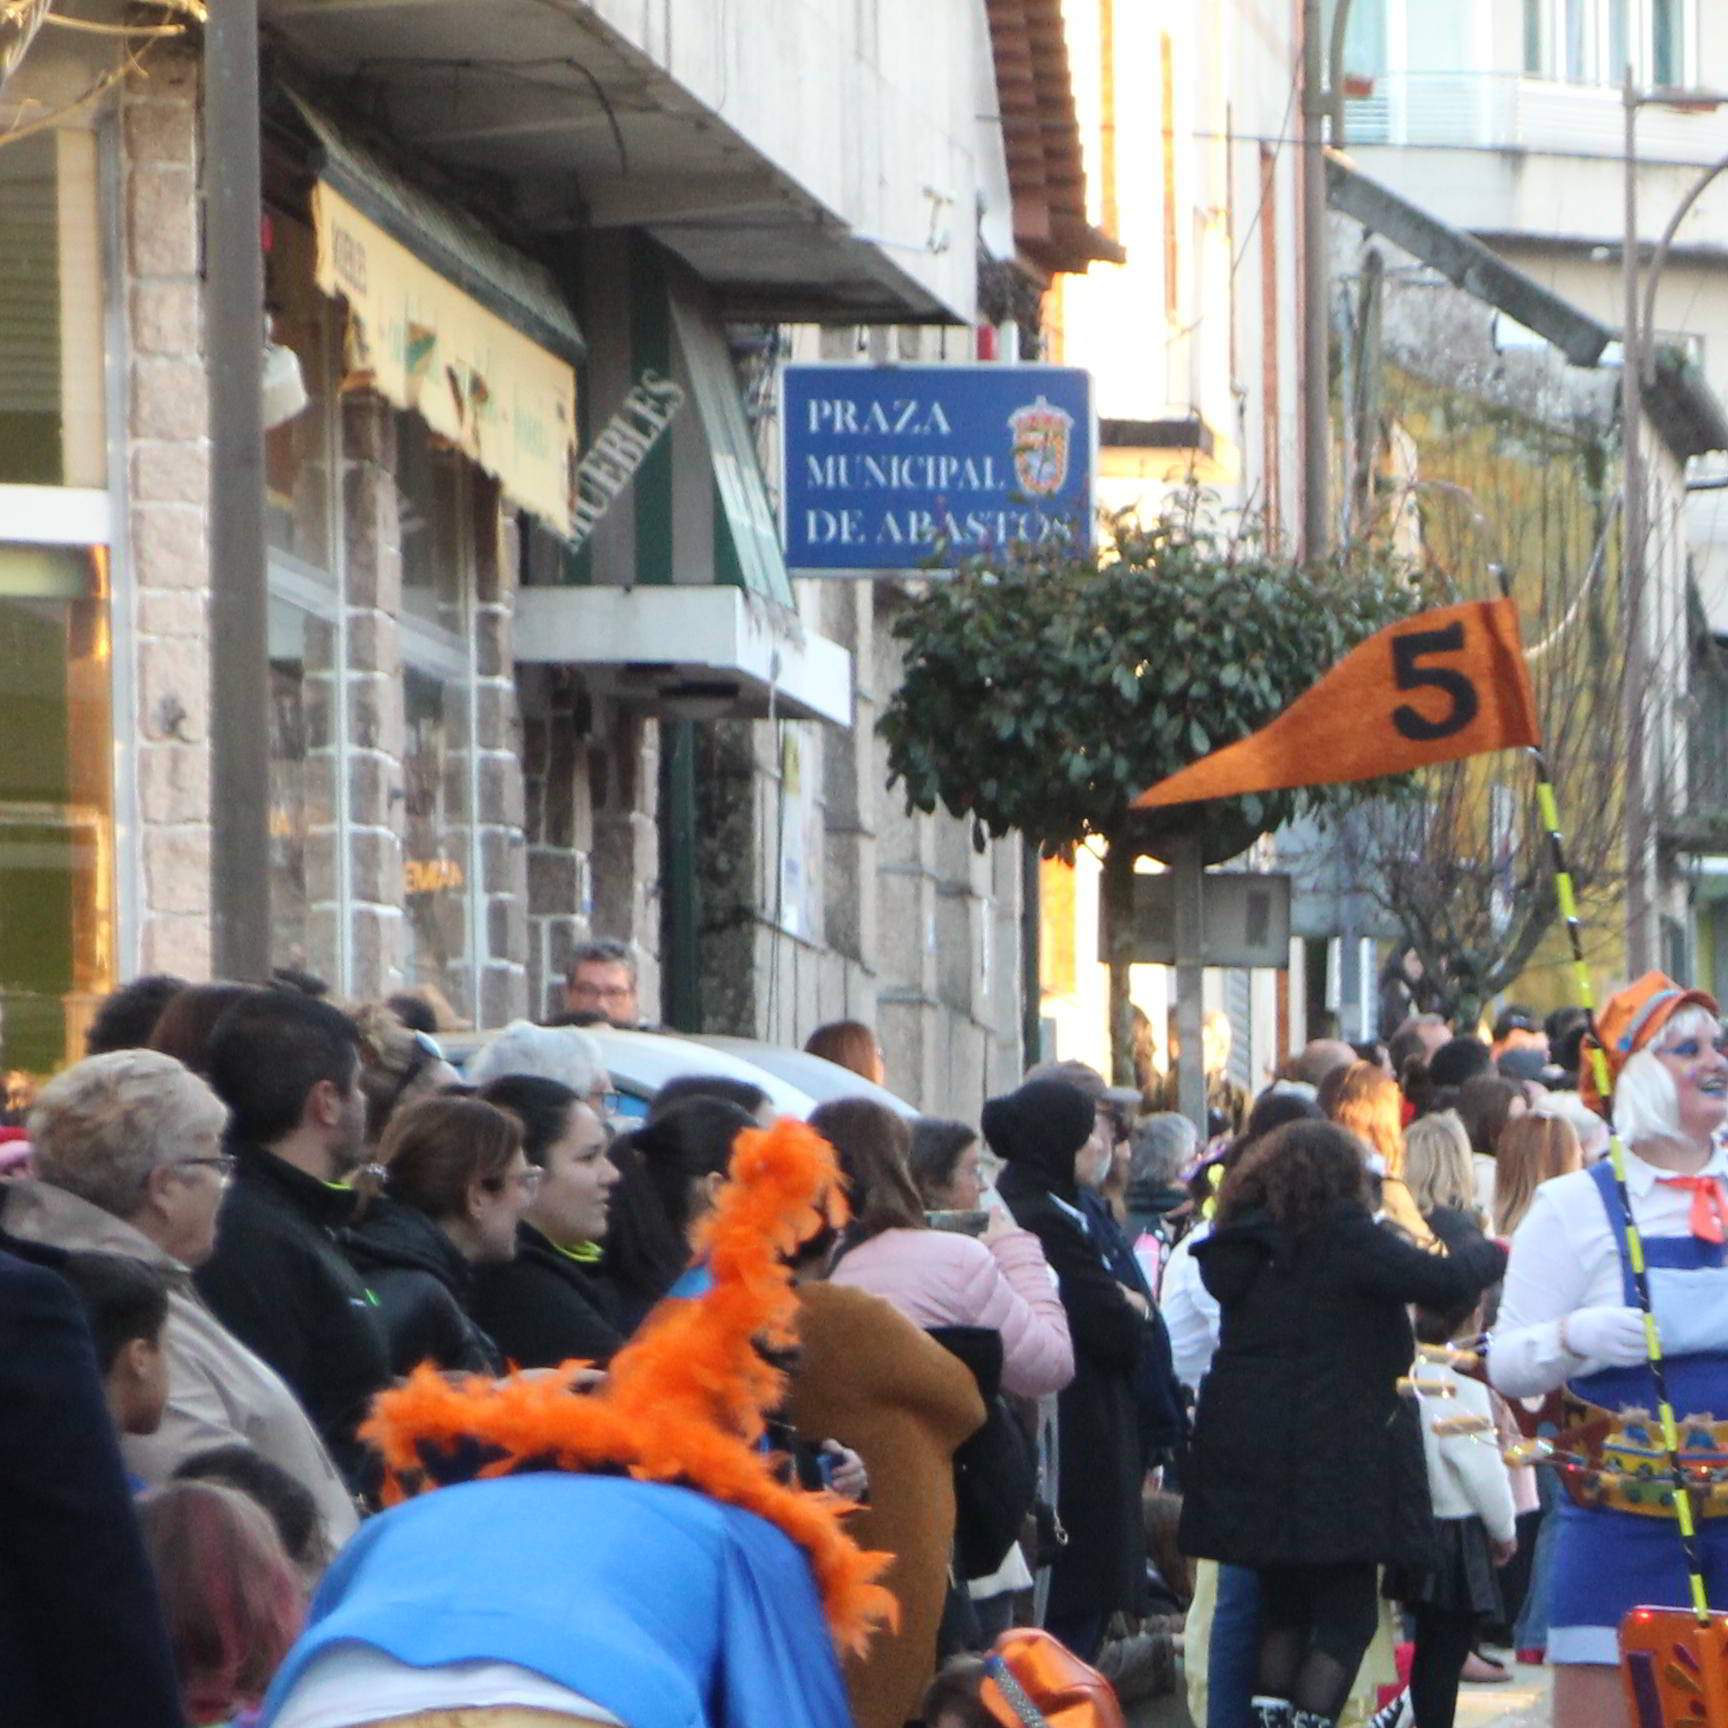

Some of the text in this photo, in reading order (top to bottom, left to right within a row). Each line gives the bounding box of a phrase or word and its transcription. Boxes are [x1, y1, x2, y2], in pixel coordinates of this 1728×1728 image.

[806, 398, 951, 435] PRAZA
[566, 368, 687, 553] MUEBLES
[806, 453, 1004, 491] MUNICIPAL
[806, 508, 1074, 547] DE ABASTOS
[1391, 621, 1479, 741] 5
